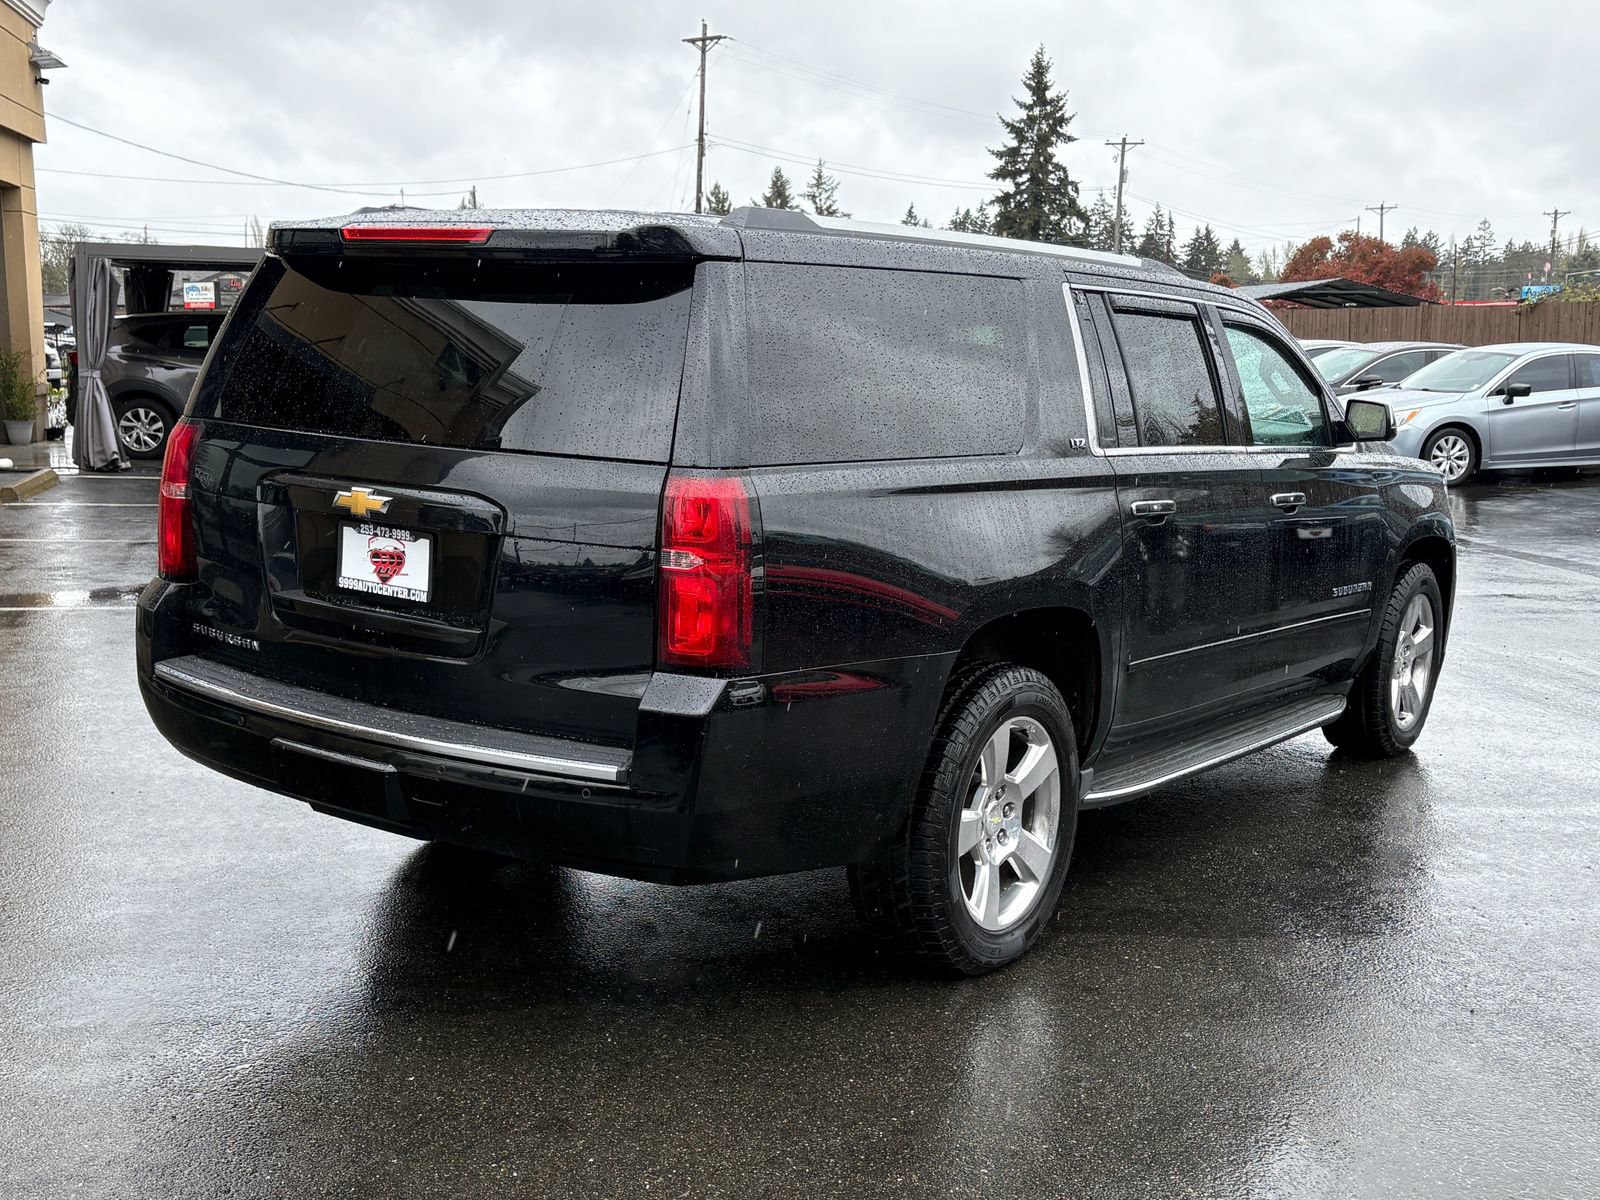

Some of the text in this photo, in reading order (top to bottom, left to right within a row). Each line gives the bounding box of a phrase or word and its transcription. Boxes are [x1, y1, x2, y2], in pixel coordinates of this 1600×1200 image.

[360, 523, 410, 541] 253-473-9999
[338, 577, 428, 603] 9999AUTOCENTER.COM
[1331, 581, 1373, 597] SUBURBAN
[192, 622, 260, 652] SUBURBAN
